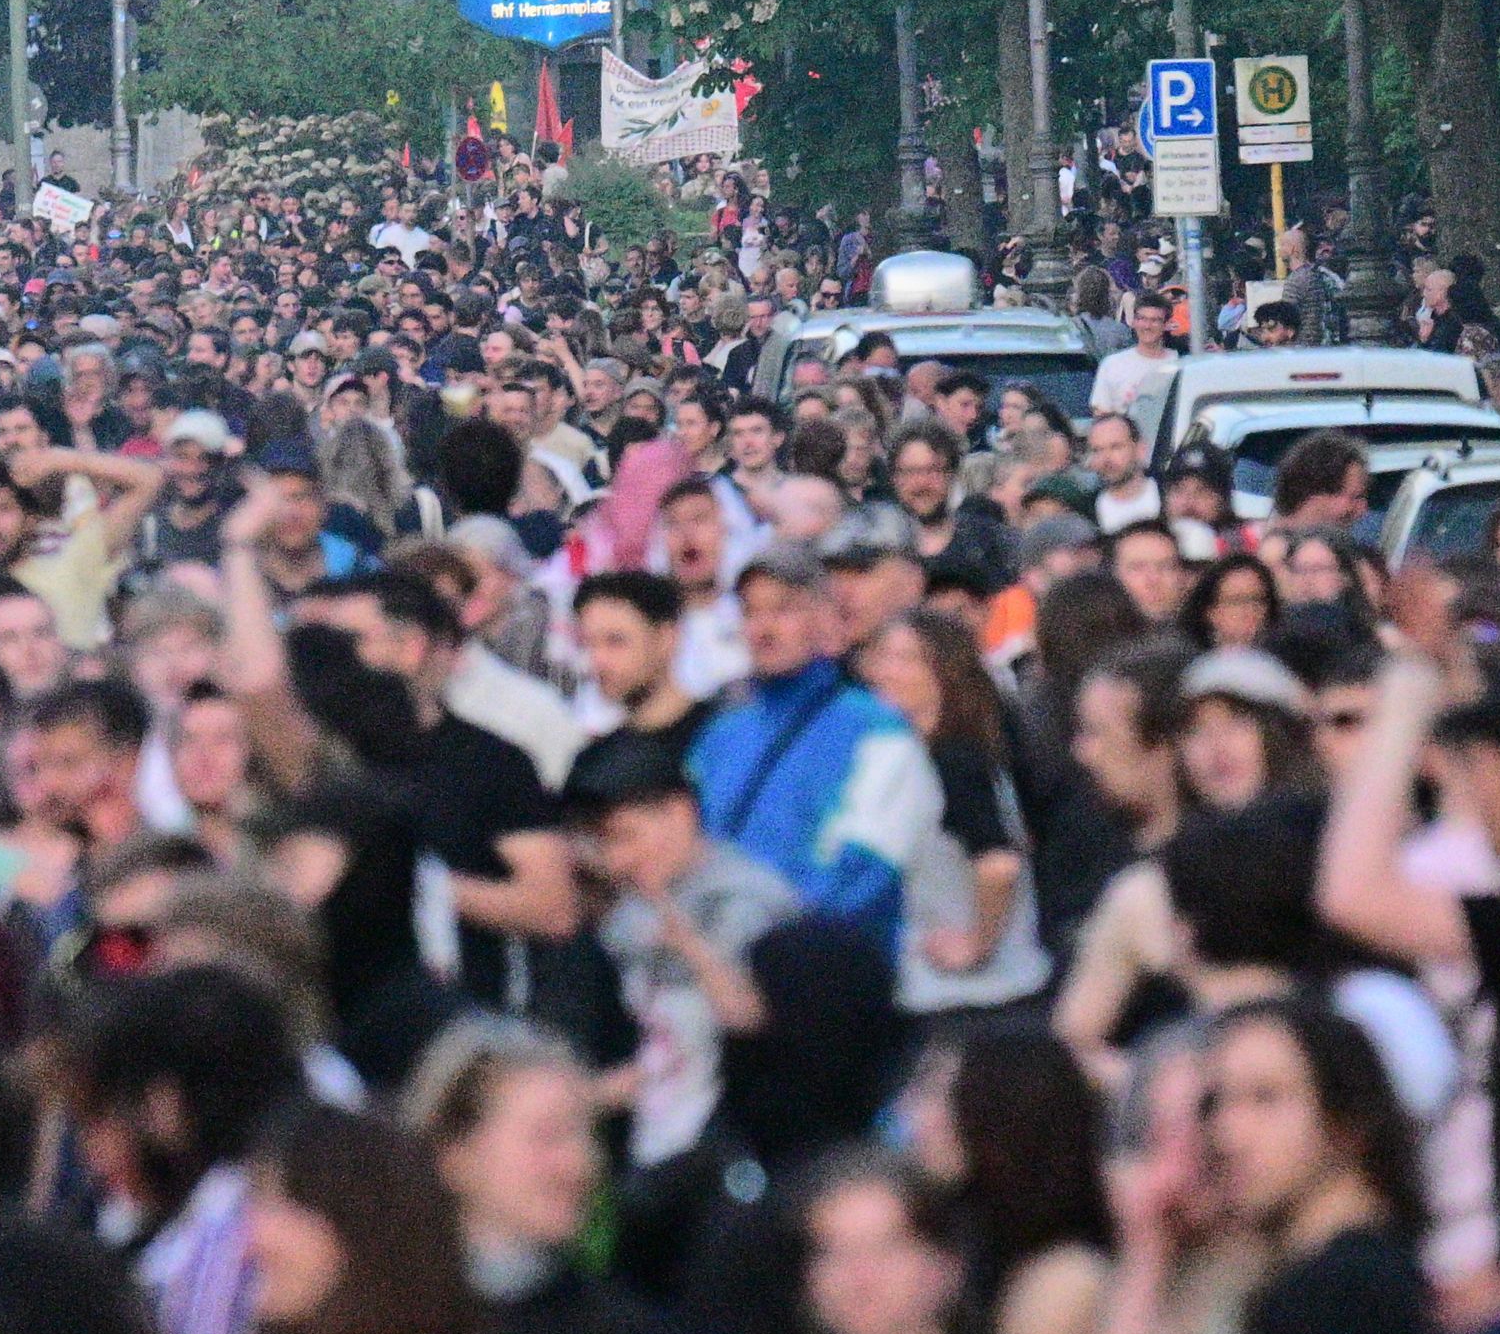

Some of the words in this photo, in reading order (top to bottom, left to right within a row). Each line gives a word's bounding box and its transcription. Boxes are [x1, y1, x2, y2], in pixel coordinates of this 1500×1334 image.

[491, 2, 514, 19] Bhf
[519, 0, 611, 18] Hermannplatz
[1159, 70, 1196, 129] P
